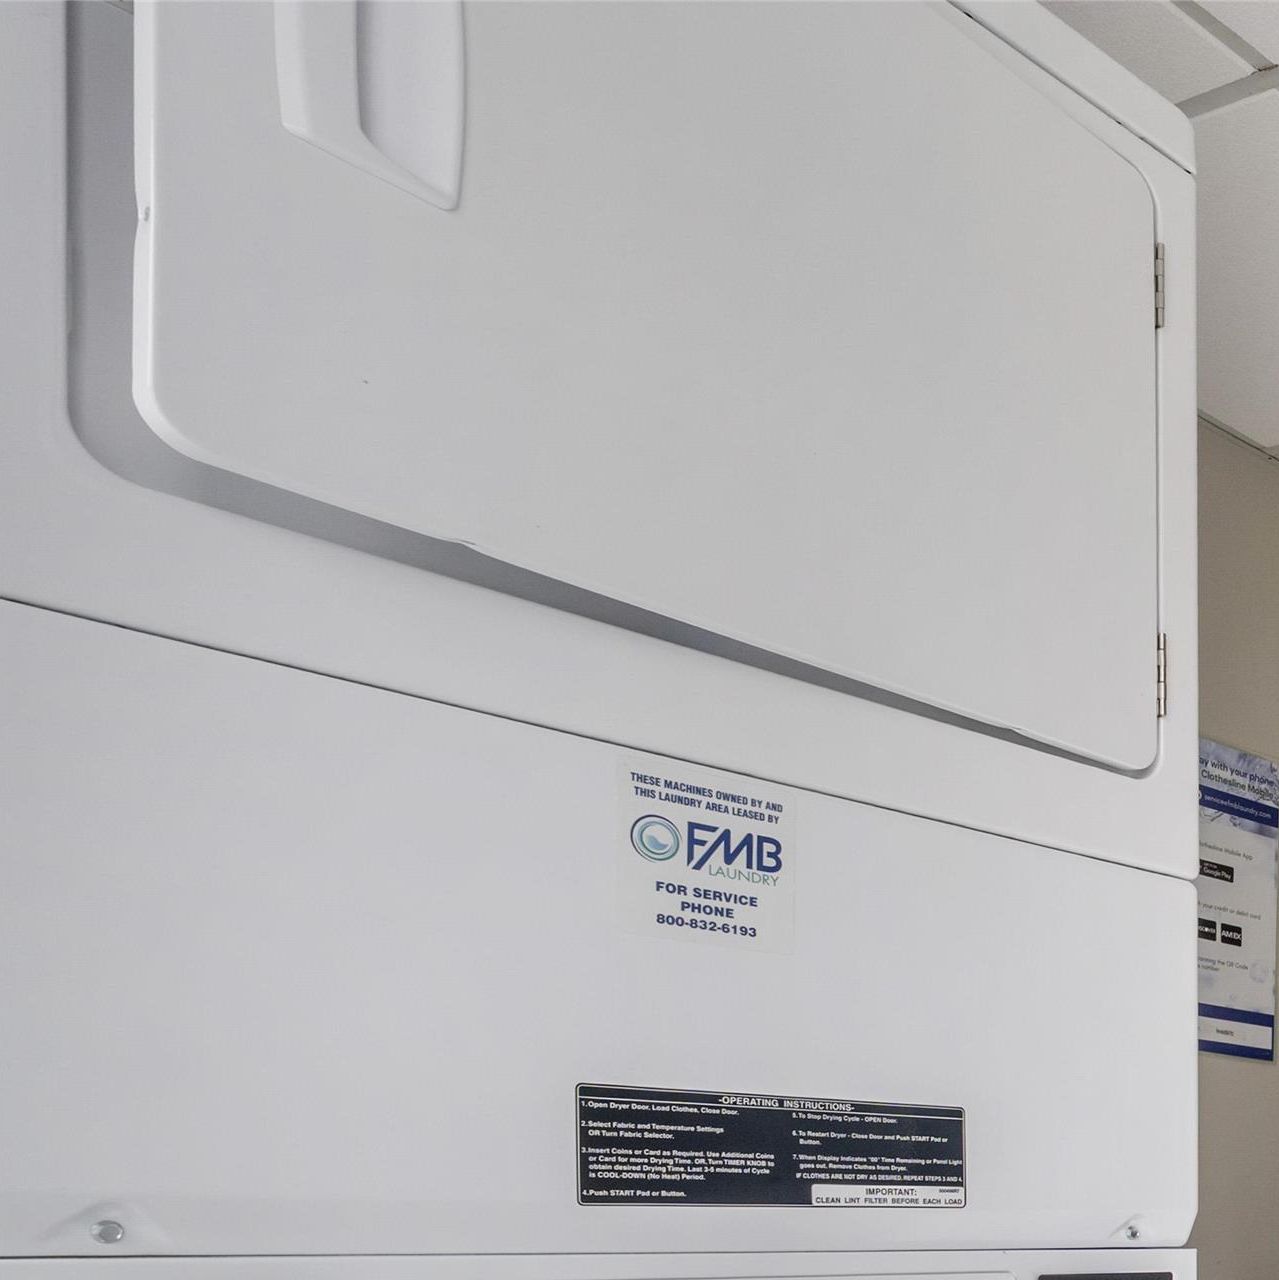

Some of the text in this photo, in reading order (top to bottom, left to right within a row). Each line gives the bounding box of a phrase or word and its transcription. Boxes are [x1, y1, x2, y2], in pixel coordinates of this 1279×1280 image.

[1211, 760, 1228, 772] with
[631, 772, 783, 813] THESE MACHINES OWNED BY AND
[634, 786, 779, 824] THIS LAUNDRY AREA LEASED BY
[687, 821, 782, 873] FMB
[709, 865, 780, 887] LAUNDRY
[656, 881, 758, 907] FOR SERVICE
[681, 901, 734, 918] PHONE
[656, 914, 757, 937] 800-832-6193
[610, 1102, 629, 1110] Dryer
[696, 1125, 724, 1134] Settings
